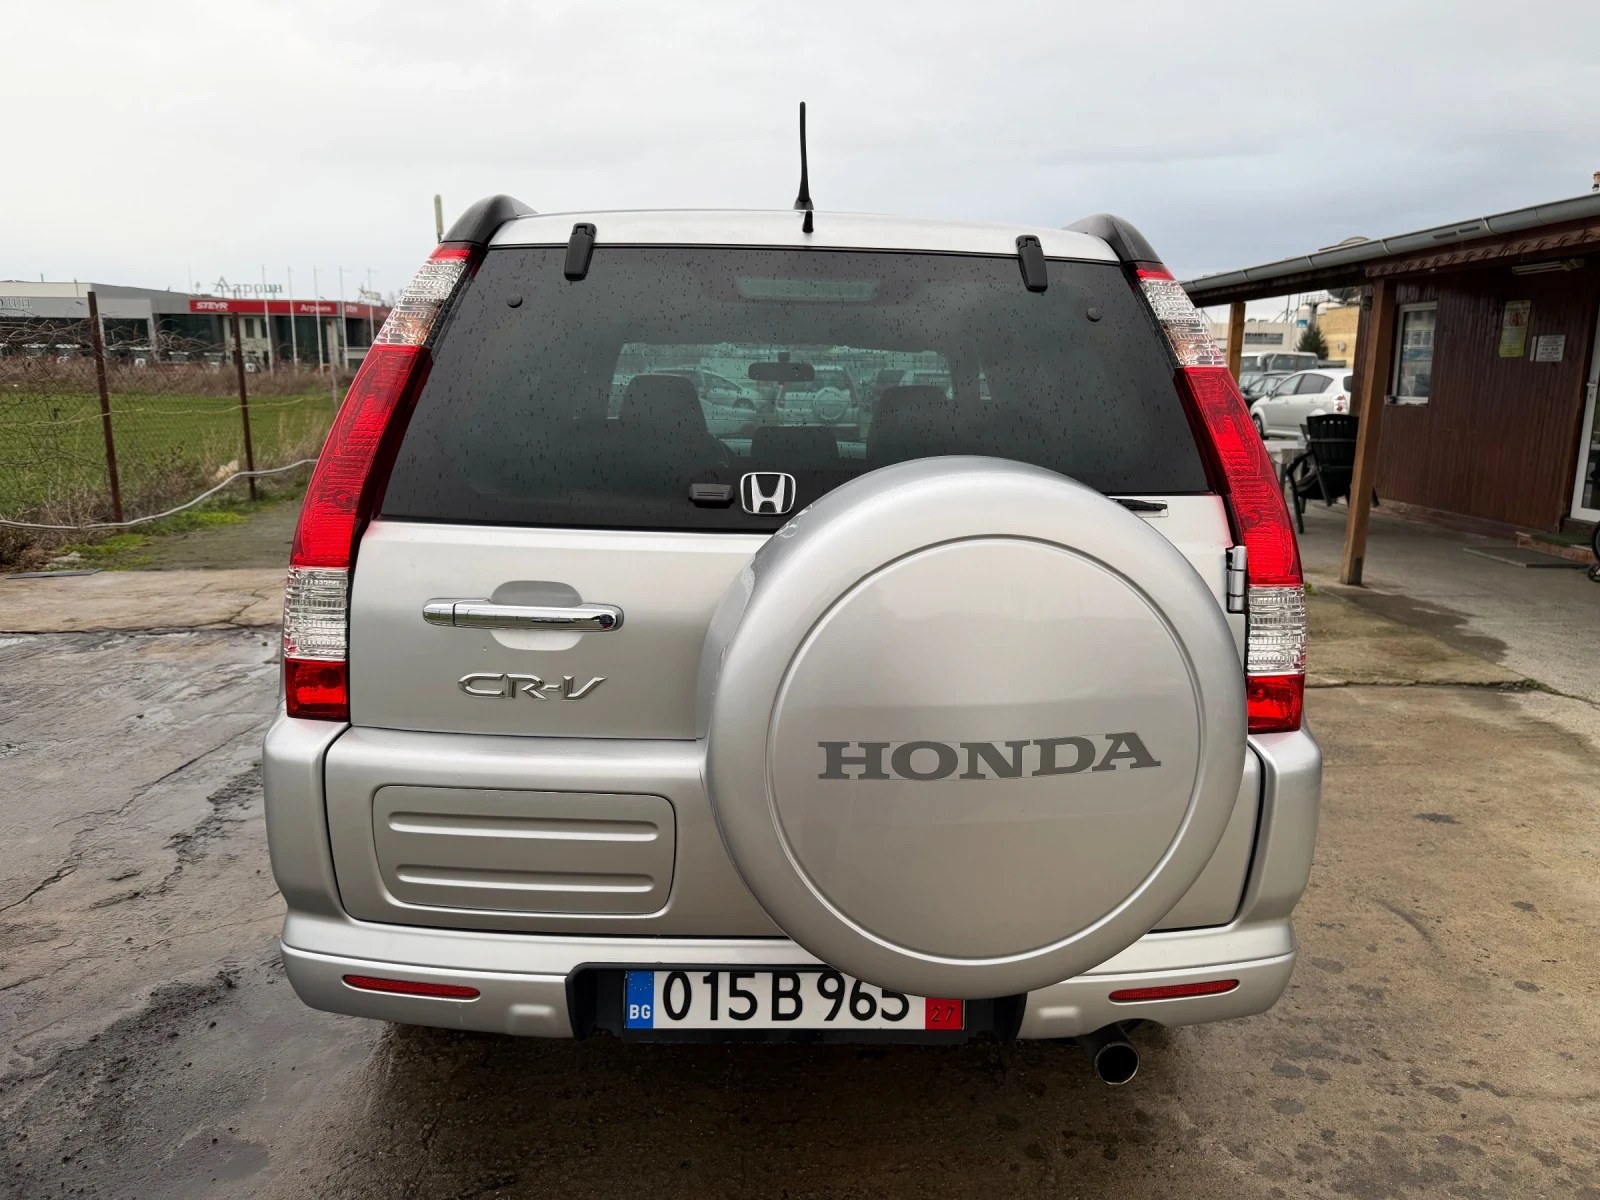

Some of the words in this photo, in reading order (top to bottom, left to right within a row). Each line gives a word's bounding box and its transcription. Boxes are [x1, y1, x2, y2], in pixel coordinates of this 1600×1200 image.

[196, 301, 229, 310] STEYR
[458, 673, 608, 700] CR-V
[818, 731, 1161, 780] HONDA
[629, 1004, 651, 1020] BG
[931, 1006, 955, 1022] 27
